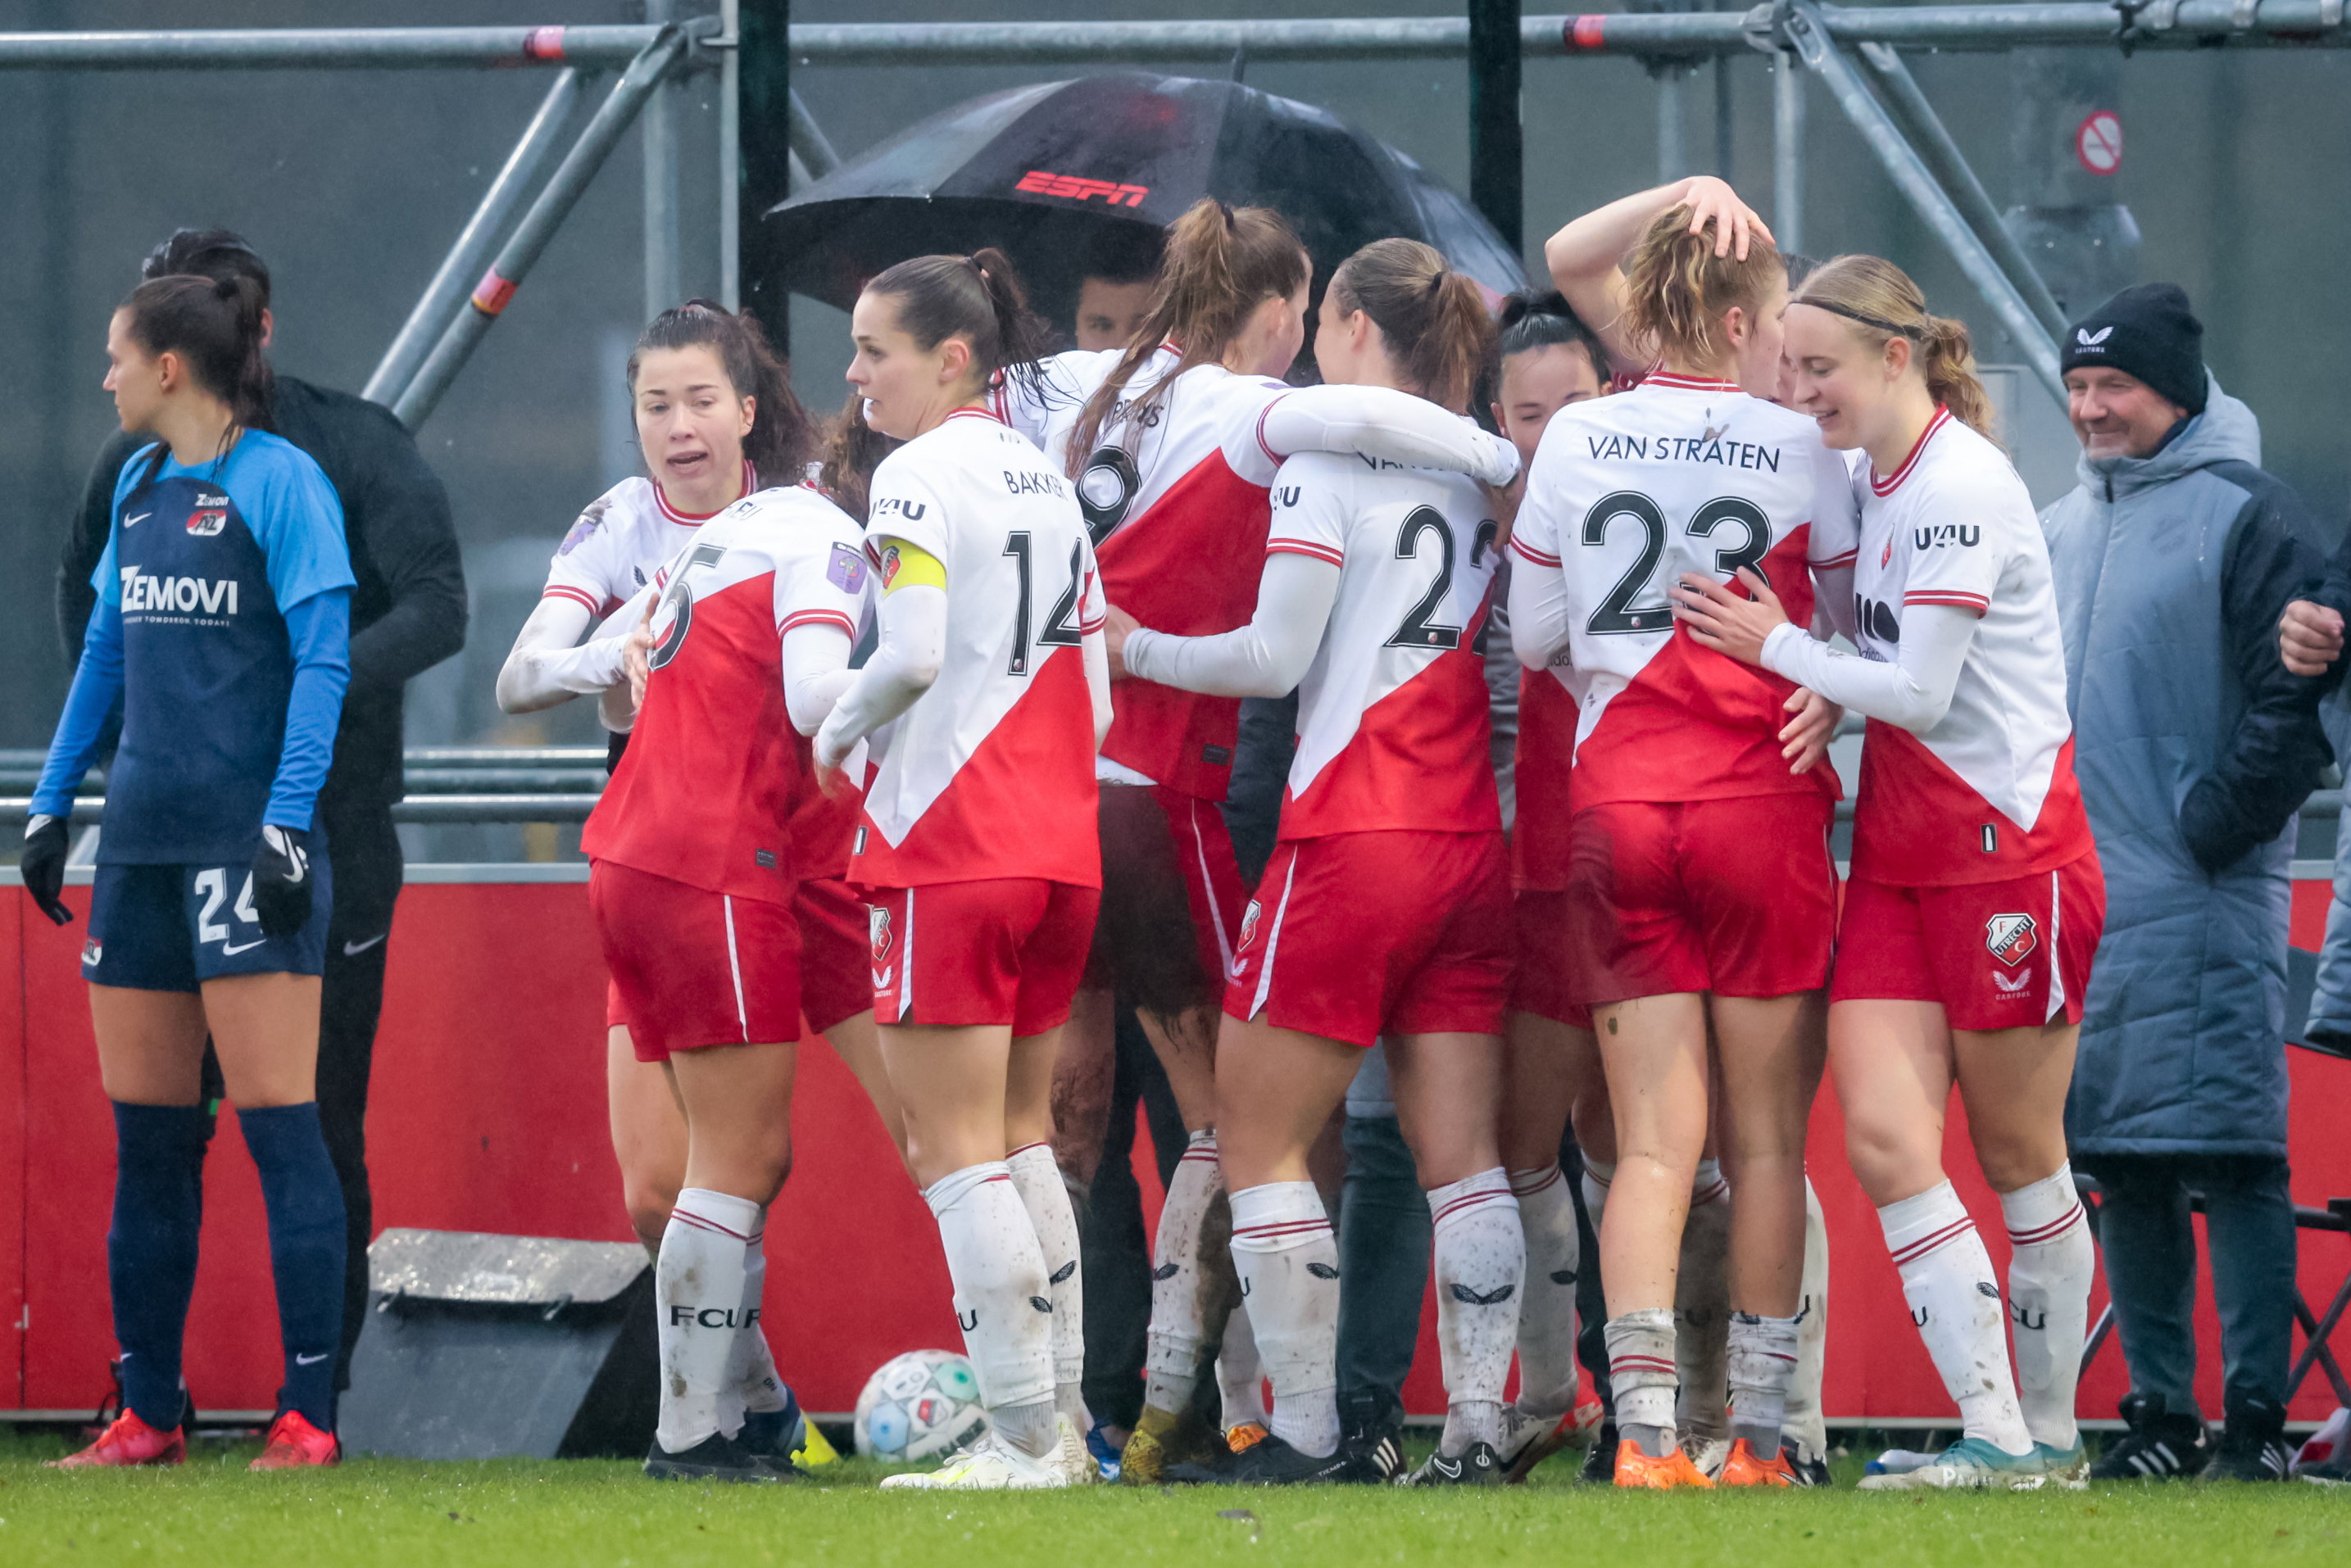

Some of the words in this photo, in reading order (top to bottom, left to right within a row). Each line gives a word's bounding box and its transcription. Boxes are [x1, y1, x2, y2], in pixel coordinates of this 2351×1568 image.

[1014, 170, 1149, 207] ESPN
[1587, 436, 1647, 460] VAN
[1654, 437, 1780, 473] STRATEN
[1582, 490, 1772, 636] 23
[120, 564, 238, 614] ZEMOVI
[1002, 531, 1082, 677] 14
[1995, 918, 2031, 955] UTRECHT
[2014, 940, 2026, 952] C
